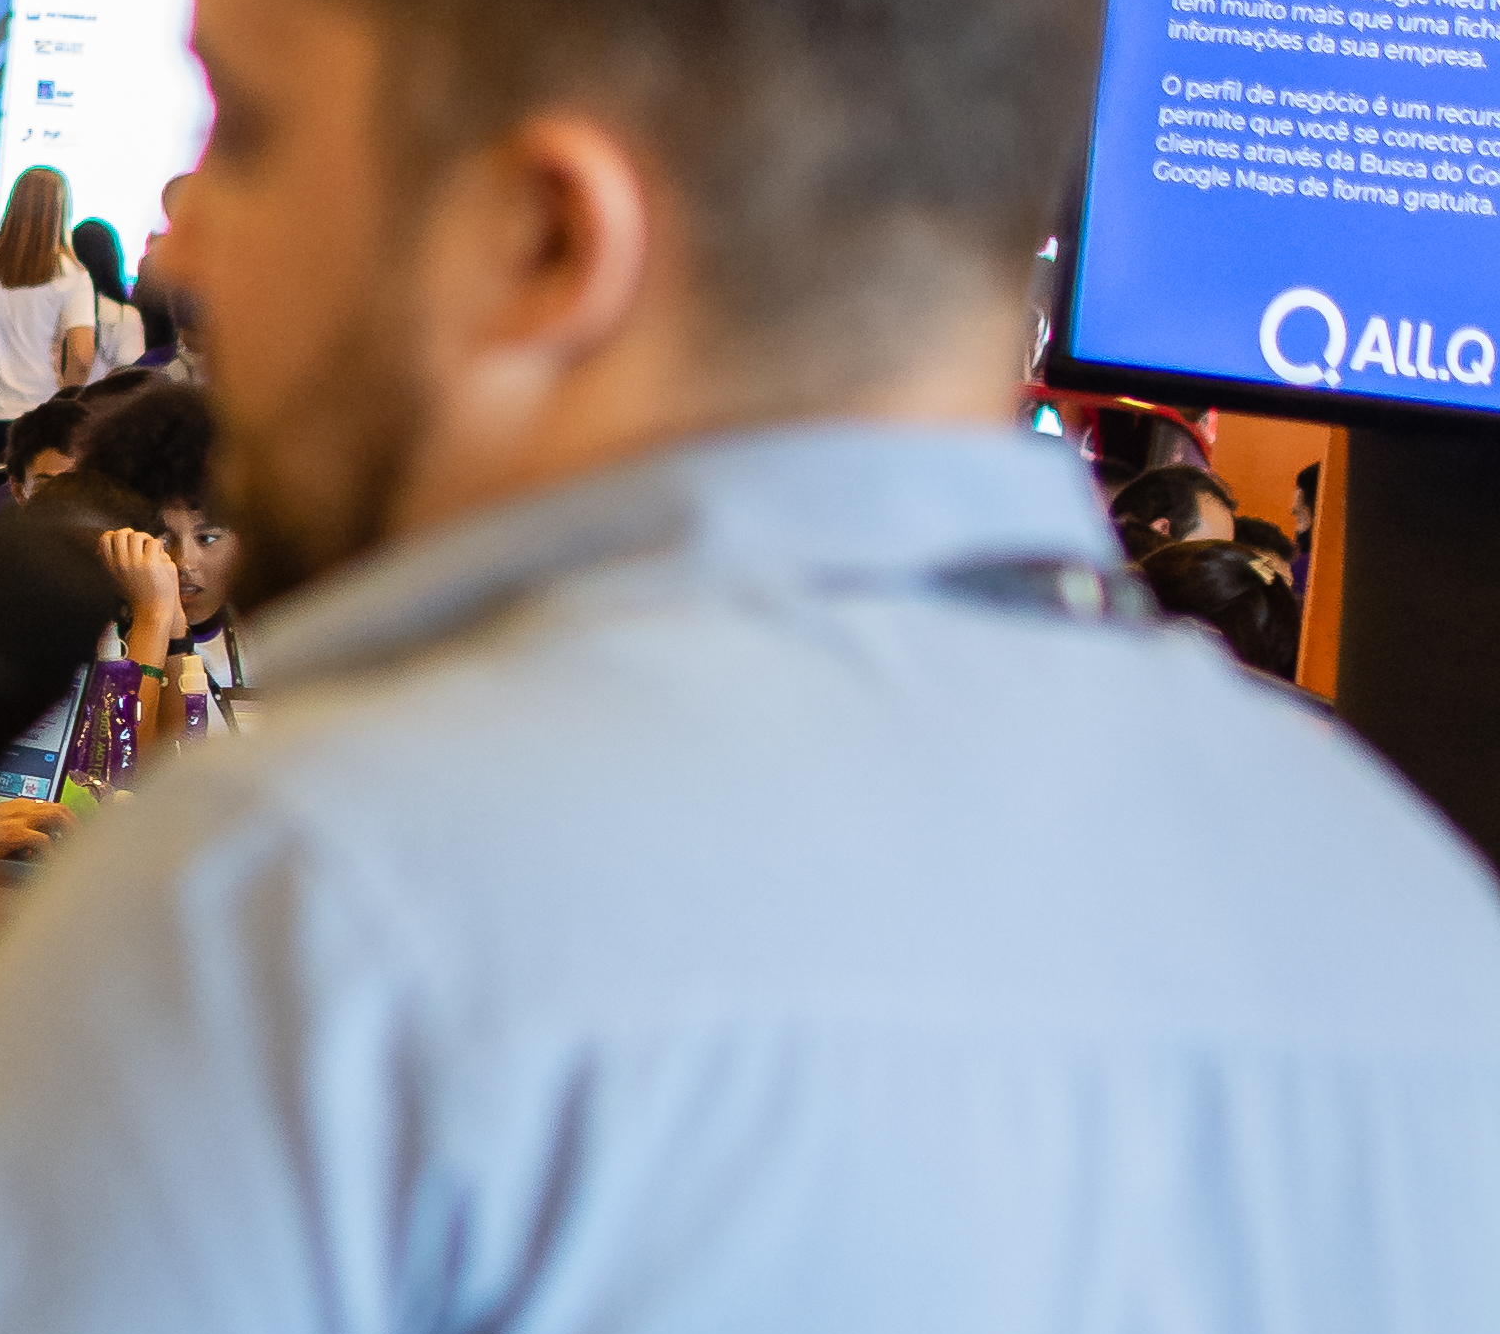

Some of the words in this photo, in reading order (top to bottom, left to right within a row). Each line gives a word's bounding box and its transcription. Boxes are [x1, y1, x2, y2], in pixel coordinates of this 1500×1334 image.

[1167, 19, 1303, 52] informações
[1306, 31, 1336, 54] da
[1339, 38, 1380, 58] sua
[1384, 42, 1487, 68] empresa.
[1291, 5, 1345, 25] mais
[1348, 10, 1393, 31] que
[1397, 14, 1449, 35] uma
[1161, 74, 1182, 96] O
[1185, 80, 1242, 102] perfil
[1245, 82, 1275, 105] de
[1280, 89, 1368, 120] negócio
[1372, 94, 1388, 117] é
[1392, 101, 1431, 120] um
[1158, 106, 1246, 131] permite
[1249, 115, 1293, 137] que
[1297, 119, 1349, 142] você
[1353, 126, 1379, 145] se
[1382, 128, 1473, 155] conecte
[1155, 133, 1240, 160] clientes
[1243, 142, 1322, 168] através
[1325, 148, 1355, 171] da
[1360, 152, 1428, 179] Busca
[1431, 159, 1463, 183] do
[1153, 160, 1231, 190] Google
[1235, 168, 1295, 197] Maps
[1299, 175, 1328, 198] de
[1332, 177, 1399, 206] forma
[1403, 188, 1497, 216] gratuita.
